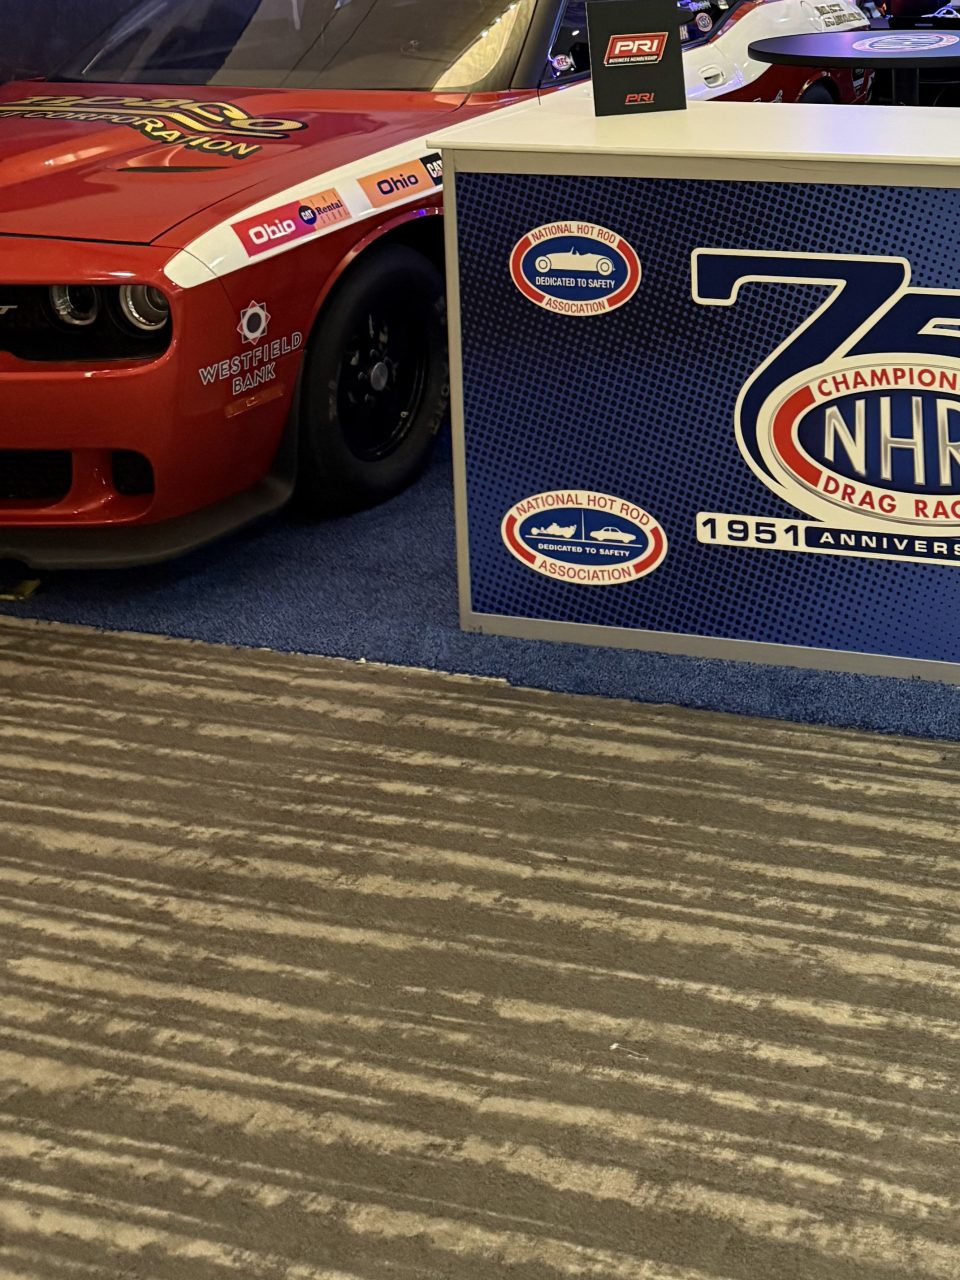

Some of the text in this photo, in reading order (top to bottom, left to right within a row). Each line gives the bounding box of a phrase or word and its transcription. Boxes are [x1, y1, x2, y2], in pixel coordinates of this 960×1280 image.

[614, 39, 659, 55] PRI
[625, 92, 655, 103] PRI
[24, 110, 262, 157] CORPORATION
[376, 173, 419, 195] Ohio
[315, 200, 343, 215] Rental
[249, 219, 296, 245] Ohio
[300, 209, 314, 221] CAT
[531, 224, 616, 244] NATIONAL HOT ROD
[535, 276, 615, 289] DEDICATED TO SAFETY
[545, 298, 606, 314] ASSOCIATION
[198, 331, 303, 386] WESTFIELD
[232, 361, 276, 395] BANK
[821, 474, 897, 515] DRAG
[516, 493, 651, 526] NATIONAL HOT ROD
[701, 517, 801, 548] 1951
[538, 543, 583, 553] DEDICATED
[599, 548, 631, 557] SAFETY
[539, 560, 632, 581] ASSOCIATION
